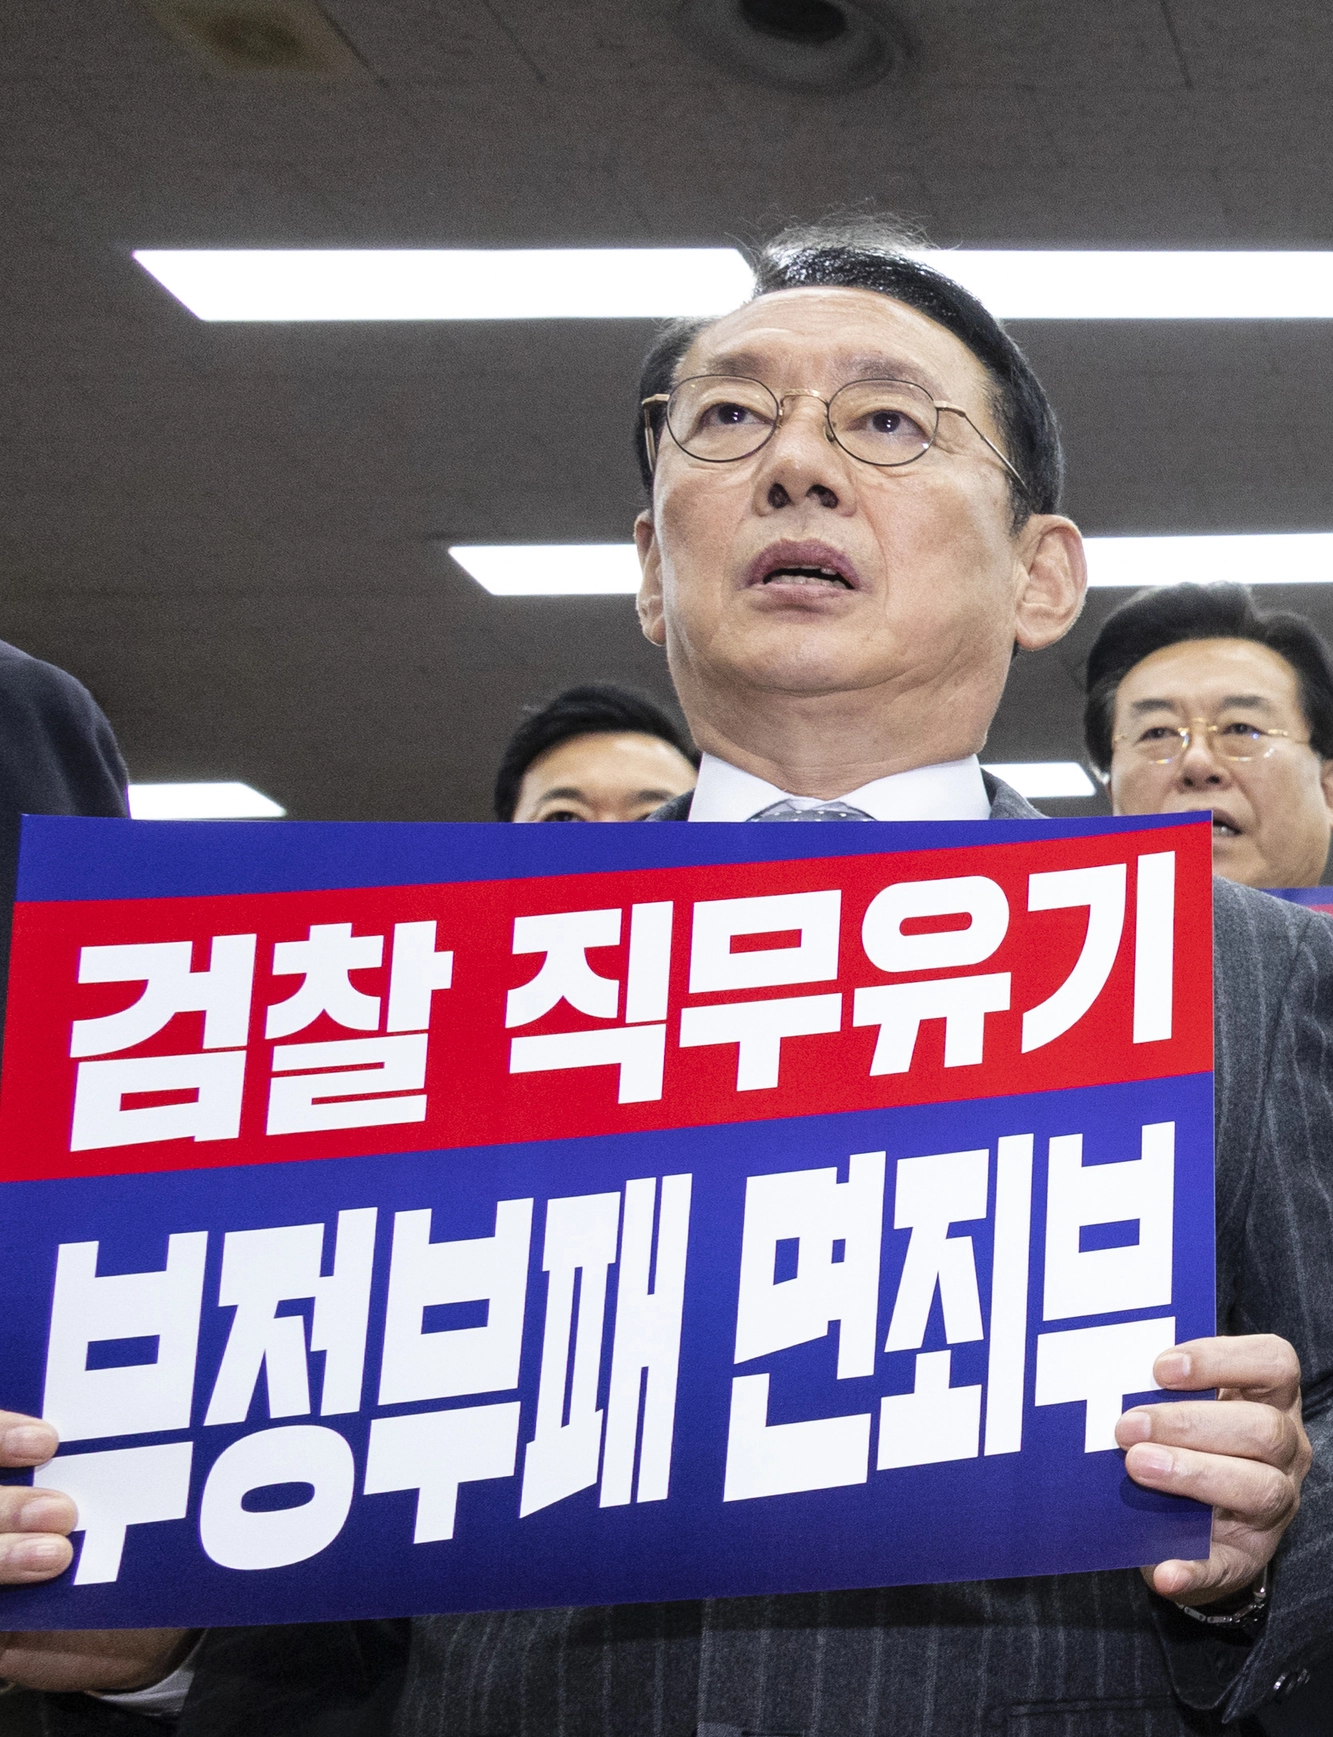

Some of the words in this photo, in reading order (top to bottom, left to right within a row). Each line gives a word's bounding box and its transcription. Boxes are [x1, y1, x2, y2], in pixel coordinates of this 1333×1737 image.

[69, 919, 453, 1153] 검찰
[506, 851, 1176, 1105] 직무유기
[32, 1173, 693, 1586] 부정부패
[722, 1121, 1176, 1503] 면죄부
